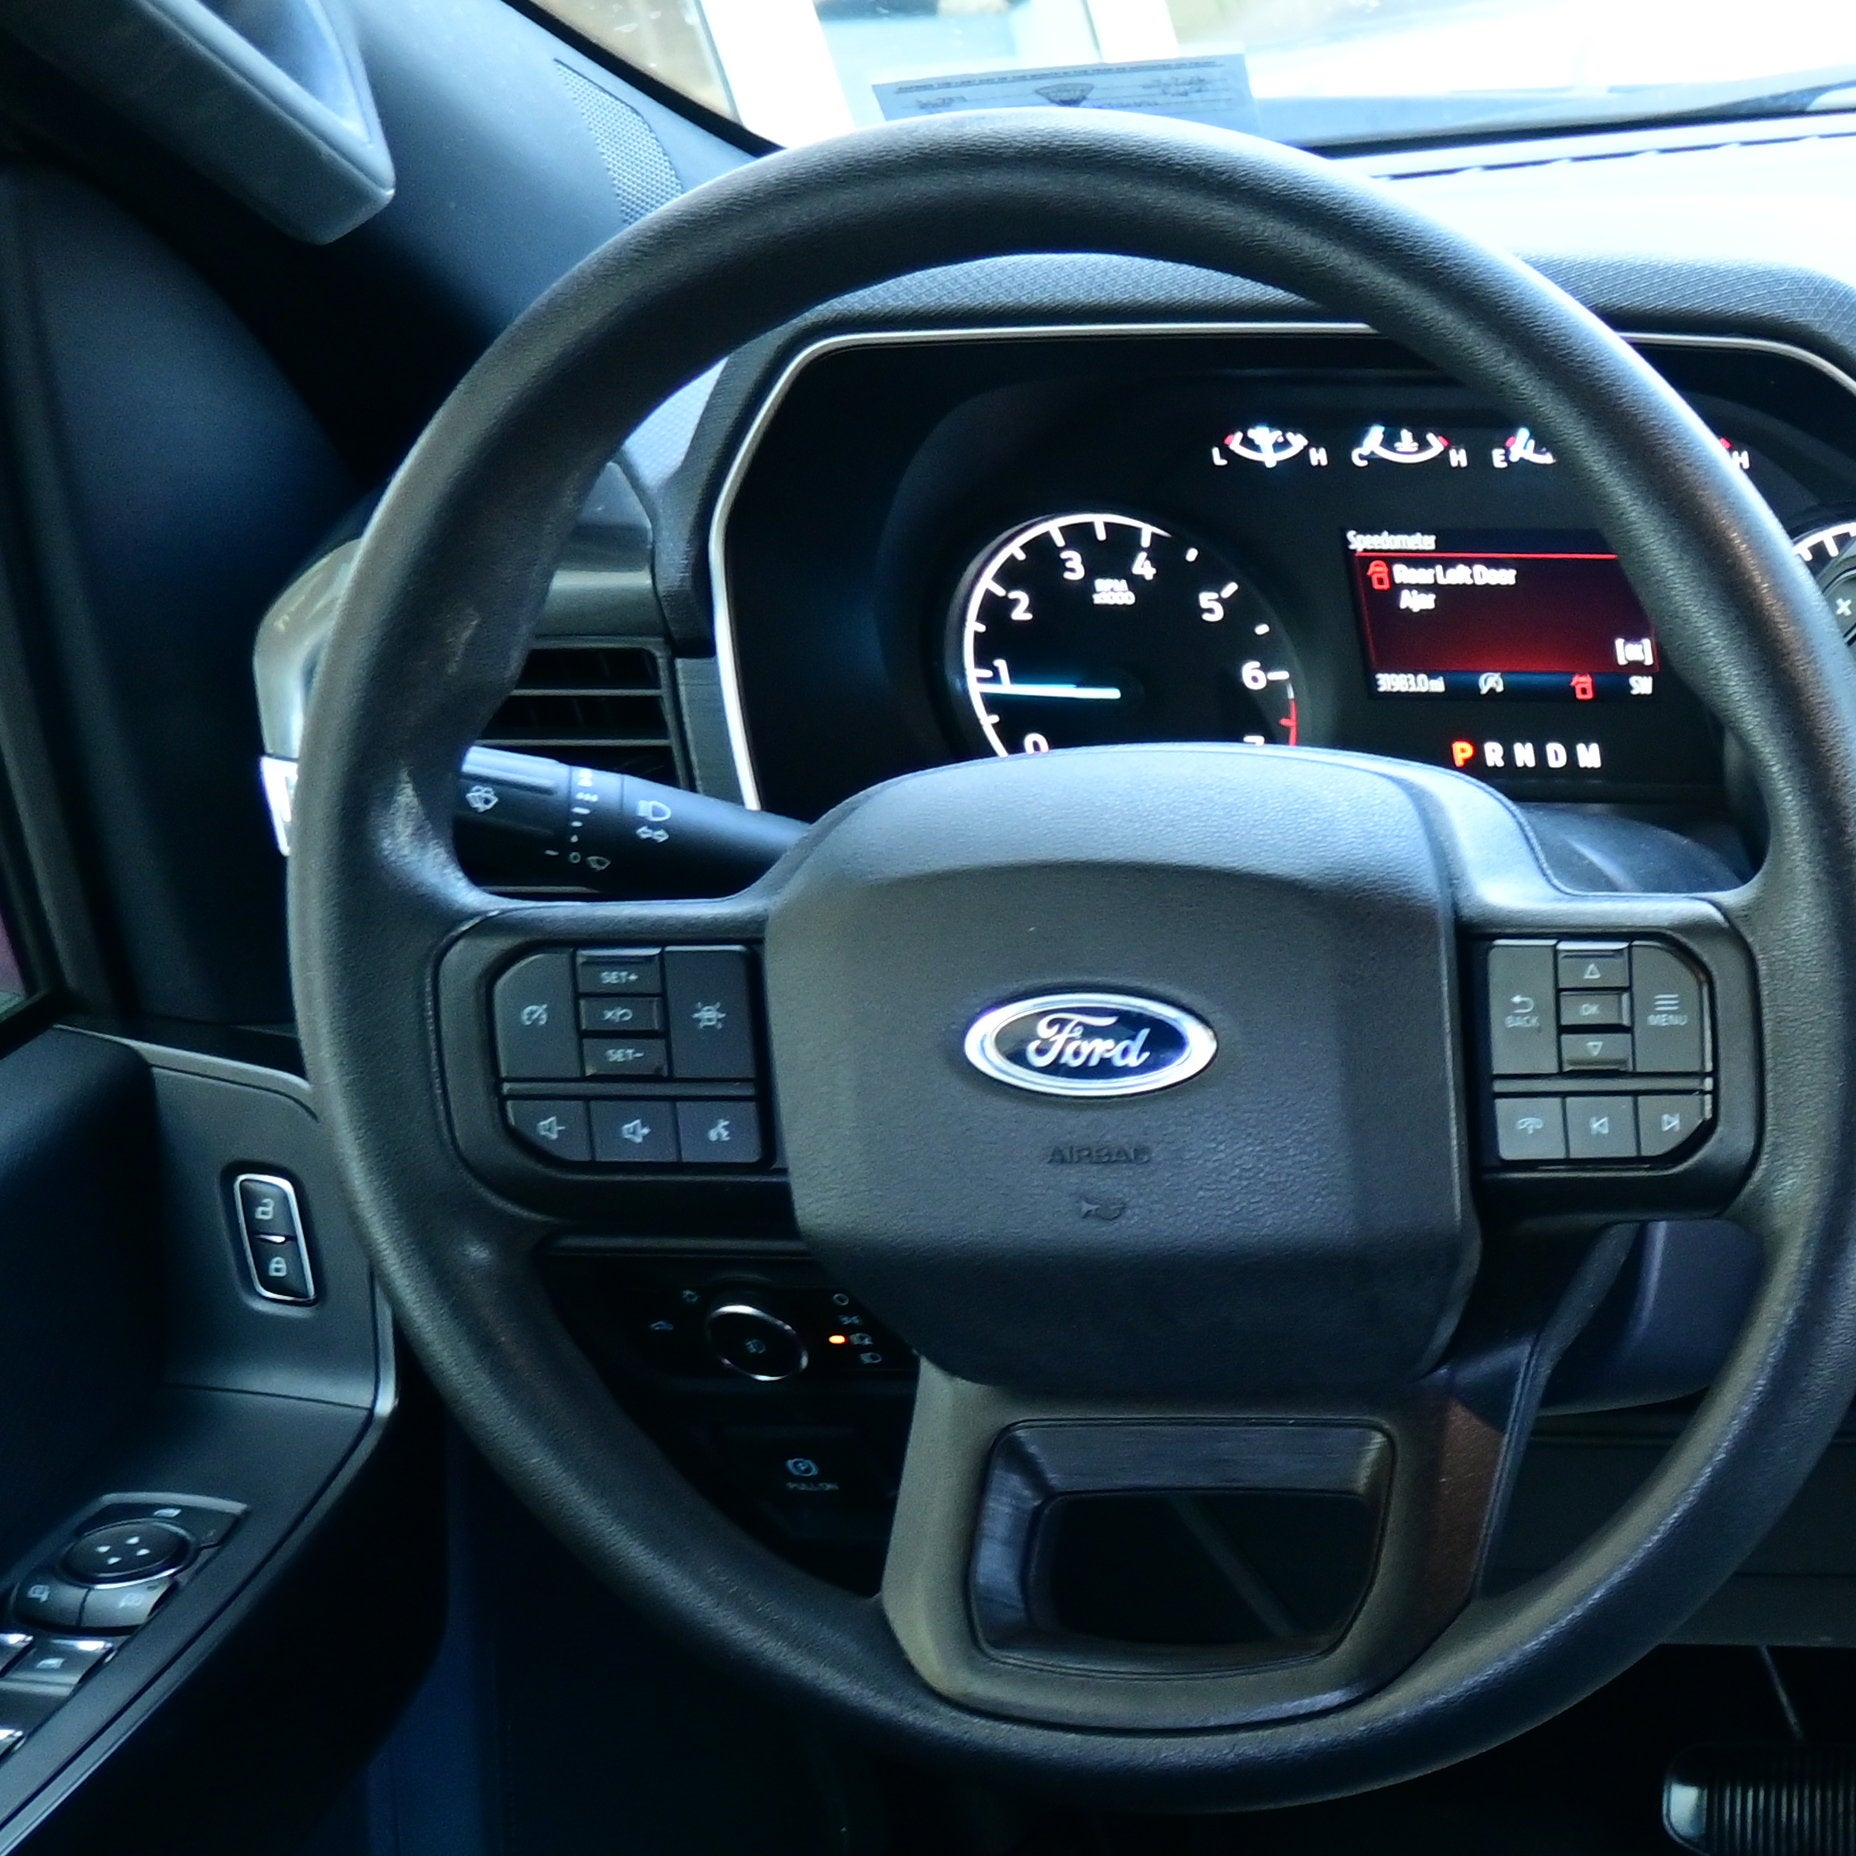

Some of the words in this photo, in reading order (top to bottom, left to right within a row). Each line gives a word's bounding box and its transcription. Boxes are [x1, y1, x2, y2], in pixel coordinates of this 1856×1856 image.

[1212, 447, 1227, 465] L
[1309, 448, 1328, 466] H
[1449, 449, 1468, 467] H
[1492, 449, 1508, 468] E
[1346, 531, 1436, 551] Speedometer
[1060, 550, 1085, 581] 3
[1132, 552, 1156, 581] 4
[1392, 564, 1435, 585] Rear
[1435, 565, 1473, 585] Left
[1473, 566, 1517, 585] Door
[1009, 591, 1034, 621] 2
[1199, 592, 1225, 622] 5
[1399, 590, 1436, 613] Ajar
[1241, 661, 1267, 690] 6
[1452, 741, 1474, 767] P
[1483, 742, 1505, 767] R
[1513, 743, 1536, 768] N
[1546, 742, 1568, 768] D
[1576, 743, 1601, 769] M
[1505, 1015, 1540, 1028] BACK
[1648, 1014, 1687, 1026] MENU
[1026, 1012, 1150, 1070] Ford
